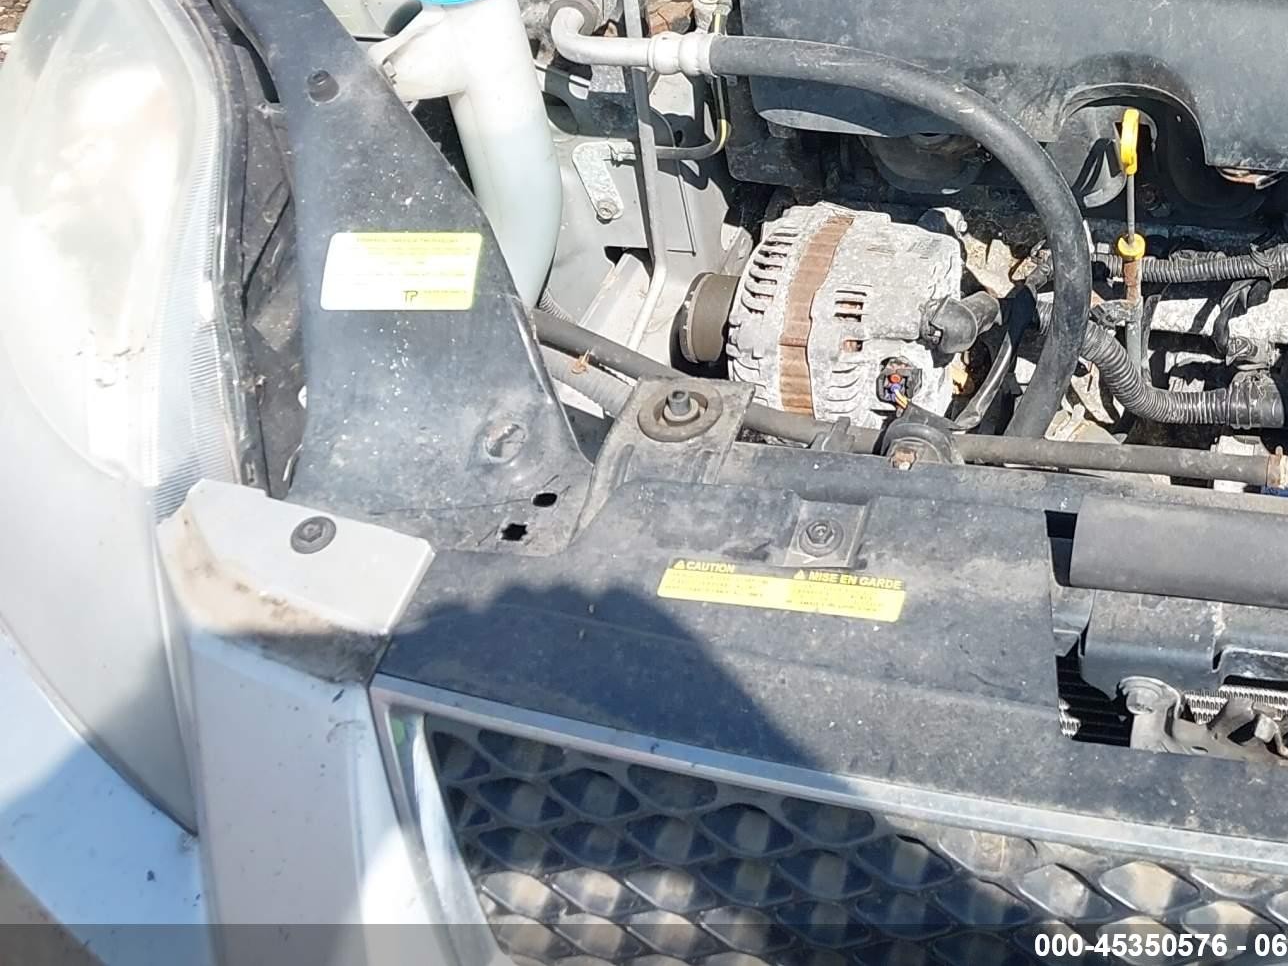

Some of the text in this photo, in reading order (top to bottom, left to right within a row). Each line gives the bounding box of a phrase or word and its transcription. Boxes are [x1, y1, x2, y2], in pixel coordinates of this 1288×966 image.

[686, 560, 736, 573] CAUTION
[808, 570, 903, 590] MISE EN GARDE
